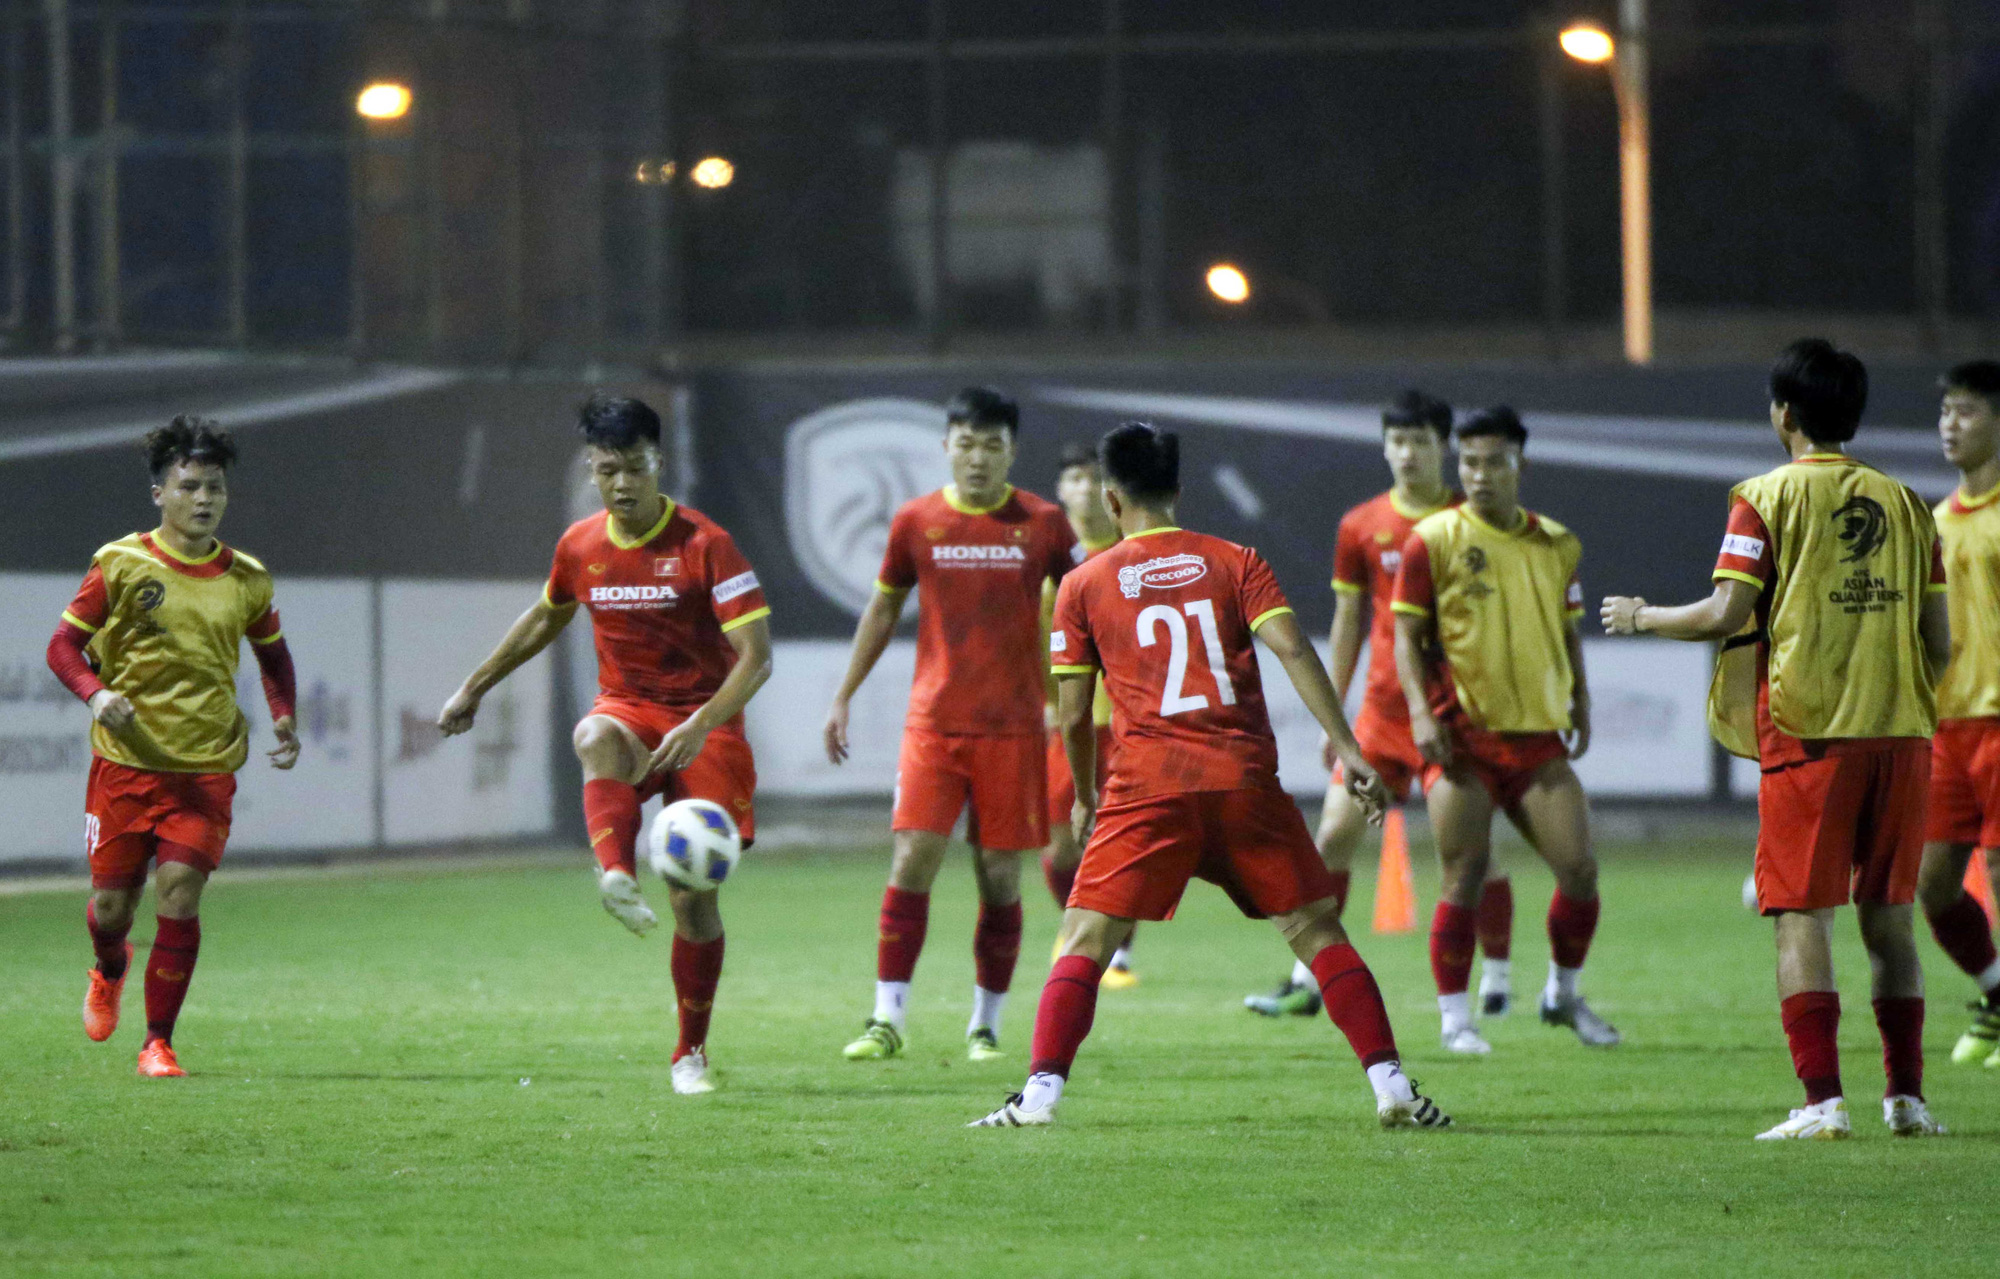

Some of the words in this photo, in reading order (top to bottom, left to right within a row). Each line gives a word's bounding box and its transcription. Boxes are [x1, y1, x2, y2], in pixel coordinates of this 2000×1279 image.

[931, 546, 1025, 560] HONDA
[1844, 577, 1885, 590] ASIAN
[590, 586, 679, 601] HONDA
[1829, 590, 1903, 603] QUALIFIERS
[594, 603, 608, 611] The
[634, 602, 642, 610] of
[1136, 599, 1237, 717] 21
